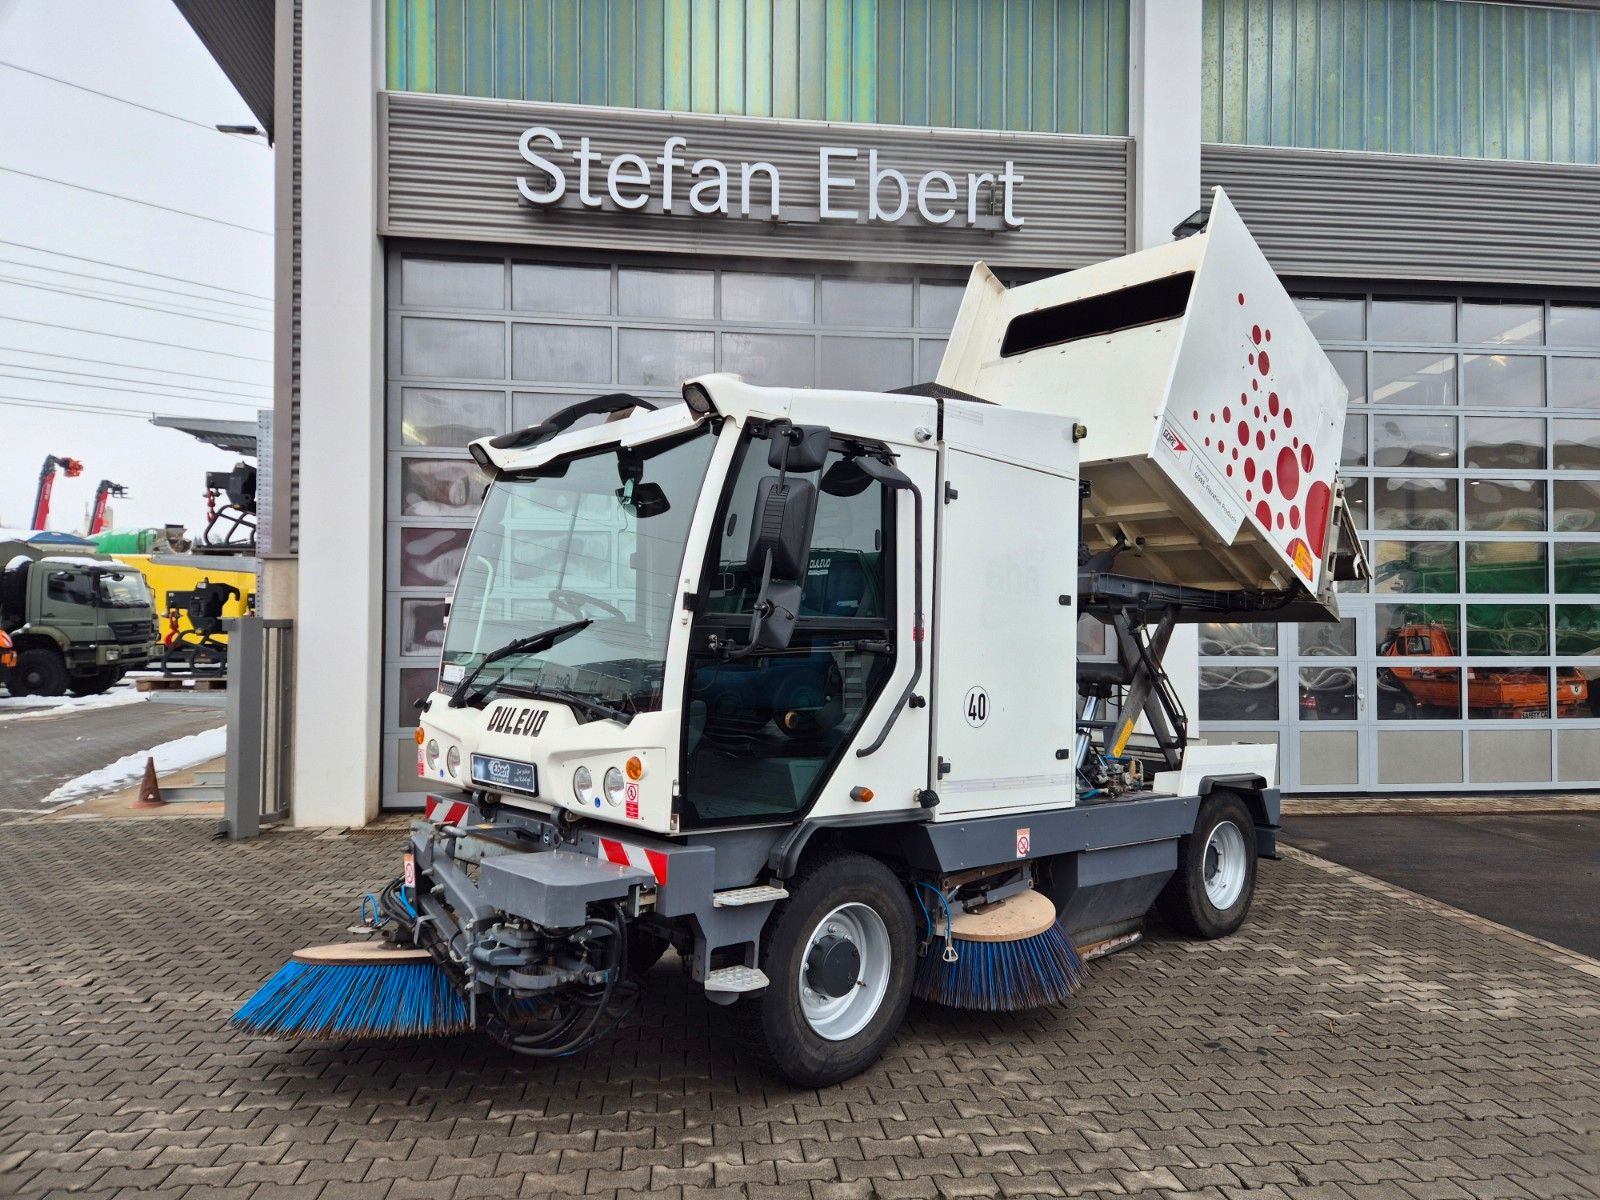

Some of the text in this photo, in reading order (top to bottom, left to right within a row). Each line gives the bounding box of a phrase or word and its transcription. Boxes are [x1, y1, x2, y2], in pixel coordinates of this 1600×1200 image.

[516, 126, 1025, 231] Stefan Ebert
[1163, 428, 1177, 448] GORE
[486, 705, 550, 738] DULEVO
[967, 693, 986, 721] 40
